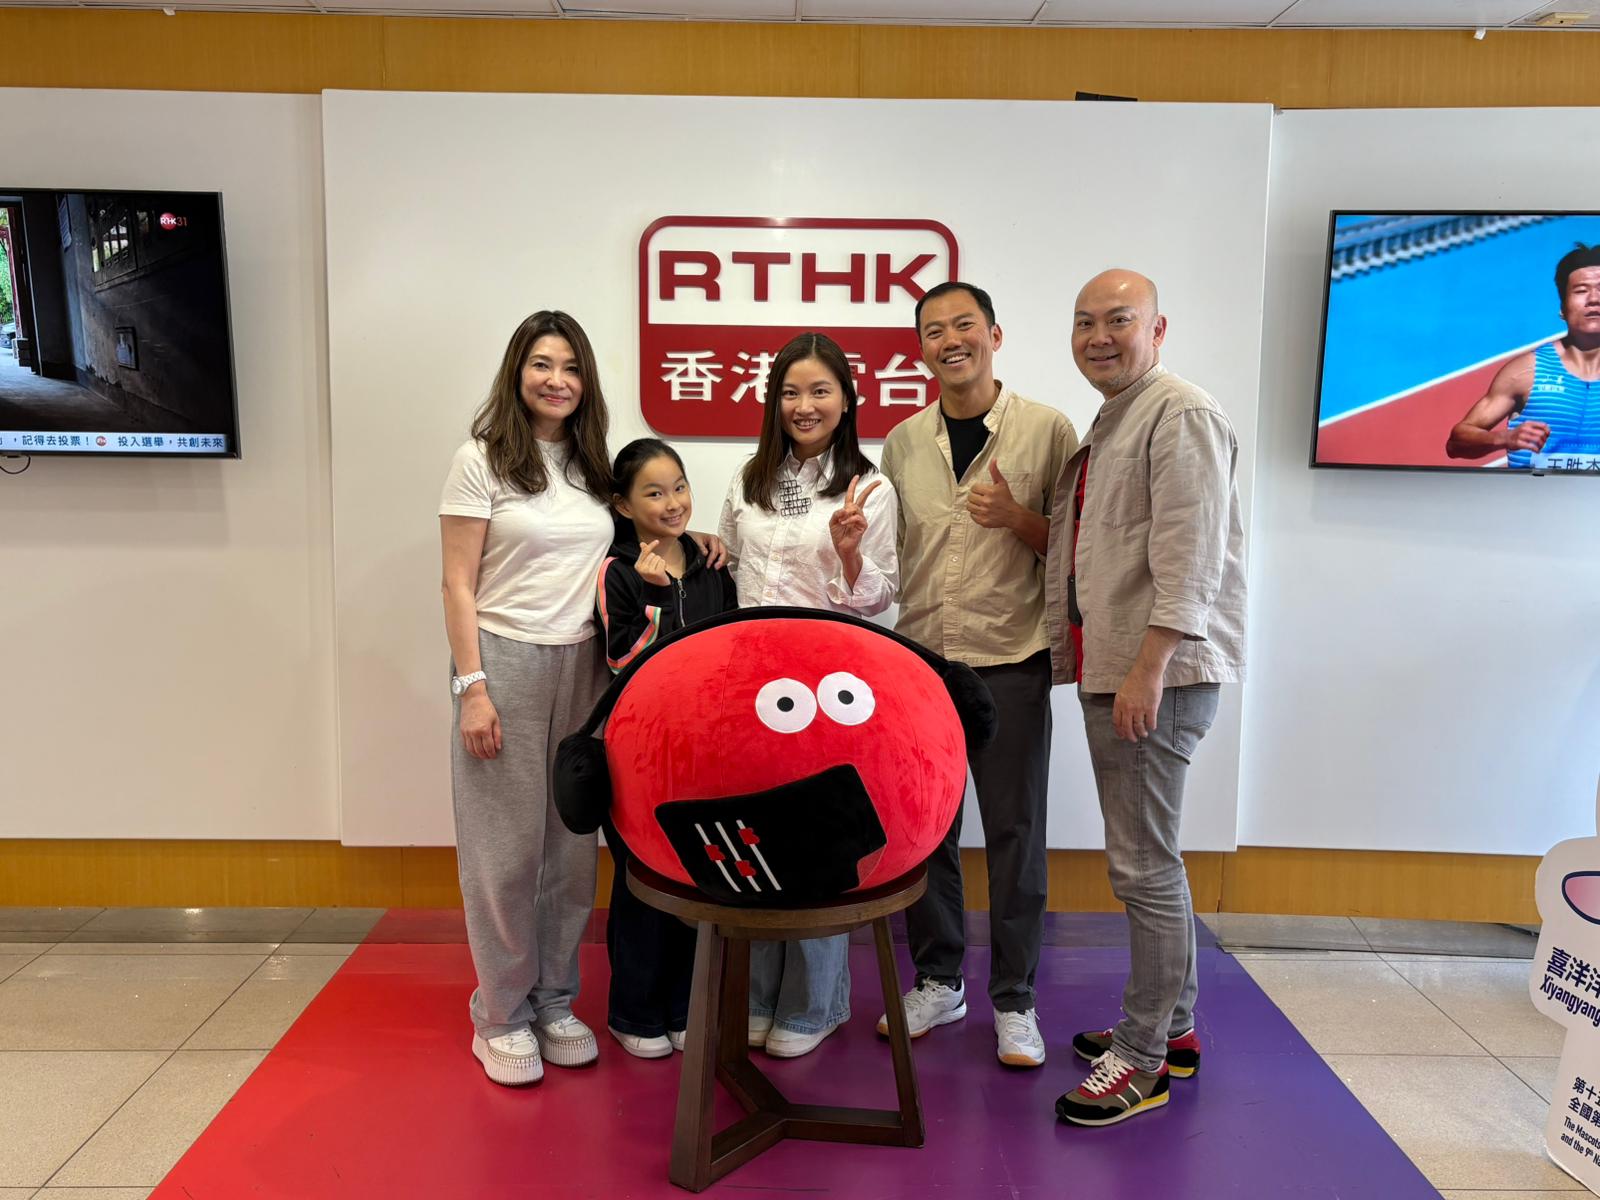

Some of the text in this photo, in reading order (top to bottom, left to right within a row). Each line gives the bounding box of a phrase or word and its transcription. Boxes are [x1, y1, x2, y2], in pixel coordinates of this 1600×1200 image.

[659, 250, 937, 303] RTHK
[660, 350, 935, 407] 香港台
[0, 434, 89, 446] ，記得去投票！
[118, 435, 224, 448] 投入選舉，共創未來
[1539, 974, 1600, 1027] Xiyangyang
[1560, 1133, 1574, 1146] and
[1573, 1139, 1584, 1154] the
[1563, 1116, 1600, 1149] The Mascots
